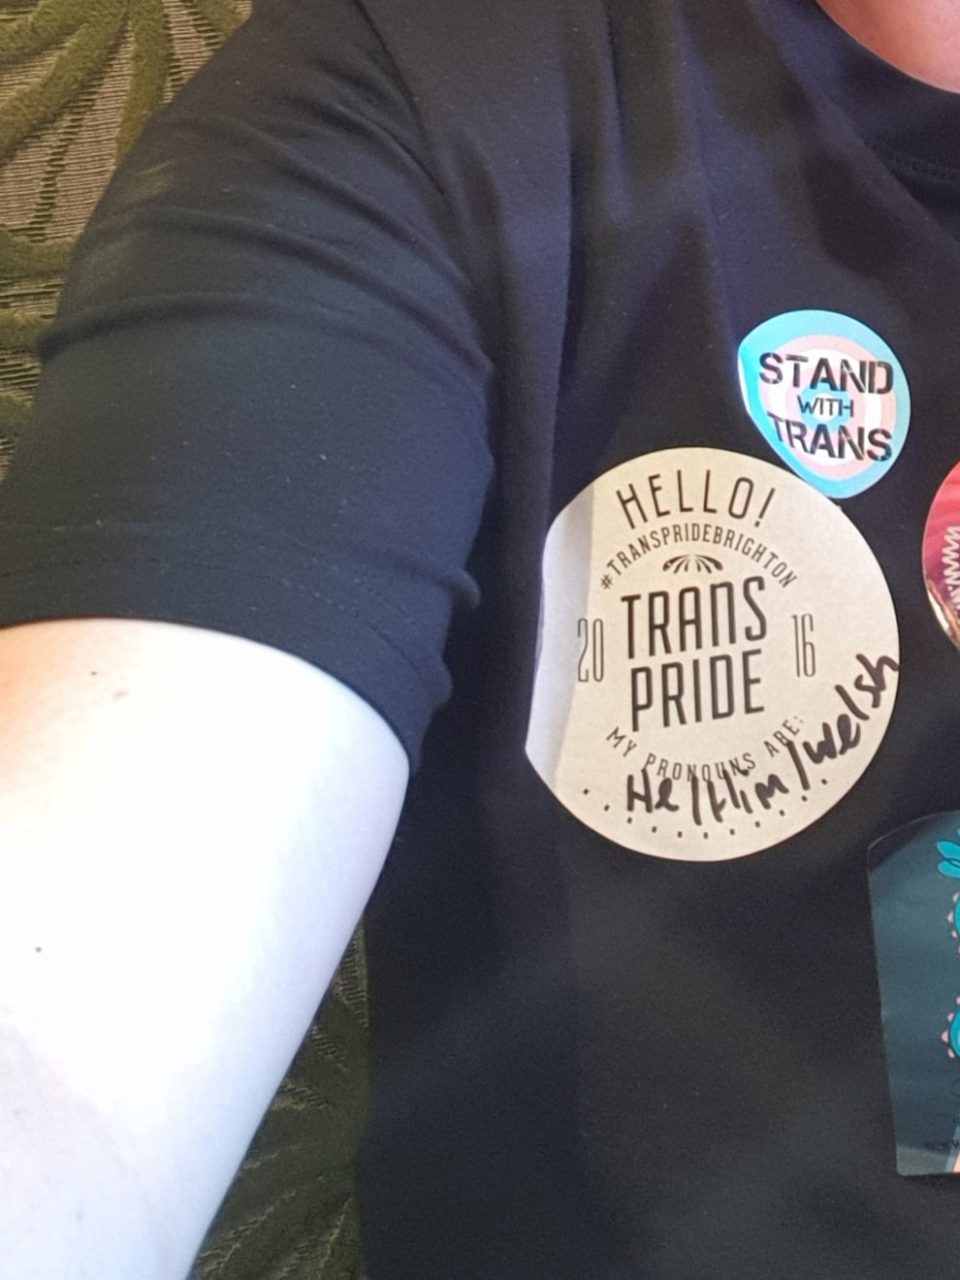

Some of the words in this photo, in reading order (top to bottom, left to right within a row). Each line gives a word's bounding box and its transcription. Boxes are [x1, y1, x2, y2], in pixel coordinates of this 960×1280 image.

[759, 351, 894, 395] STAND
[767, 411, 893, 462] TRANS
[796, 394, 854, 418] WITH
[616, 469, 776, 530] HELLO!
[600, 523, 798, 590] #TRANSPRIDEBRIGHTON
[620, 575, 768, 660] TRANS
[791, 613, 817, 678] 16
[577, 617, 605, 683] 20
[630, 648, 765, 732] PRIDE
[605, 726, 638, 758] MY
[643, 752, 756, 783] PRONOUNS
